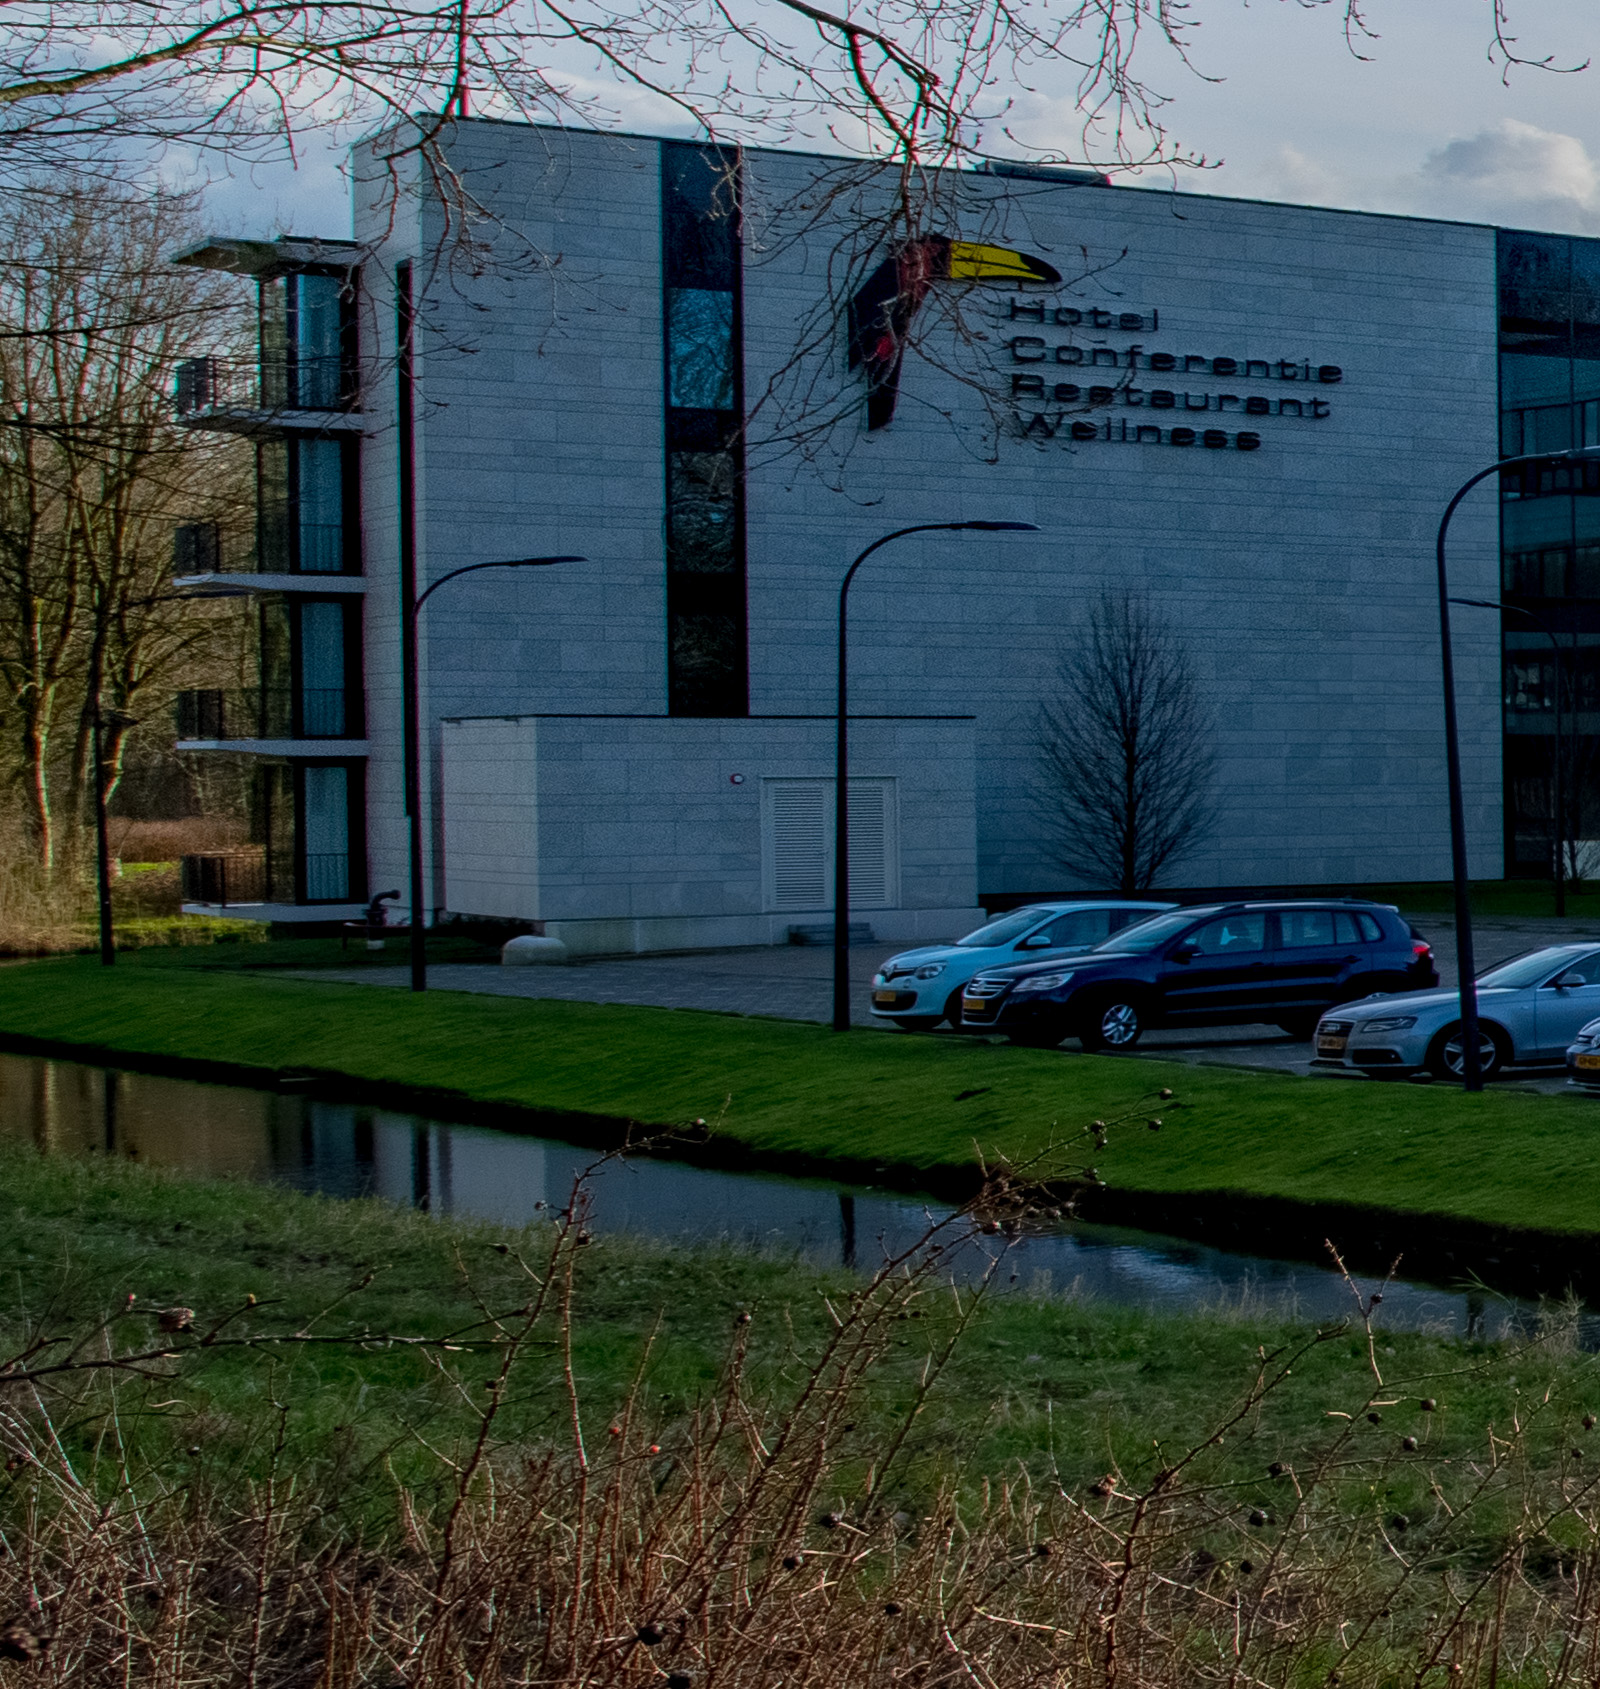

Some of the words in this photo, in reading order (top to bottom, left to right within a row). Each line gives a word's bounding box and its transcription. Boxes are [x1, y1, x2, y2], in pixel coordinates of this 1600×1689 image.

[1010, 297, 1159, 332] Hotel
[1010, 336, 1343, 384] Conferentie
[1010, 374, 1331, 419] Restaurant
[1010, 411, 1261, 451] Wellness
